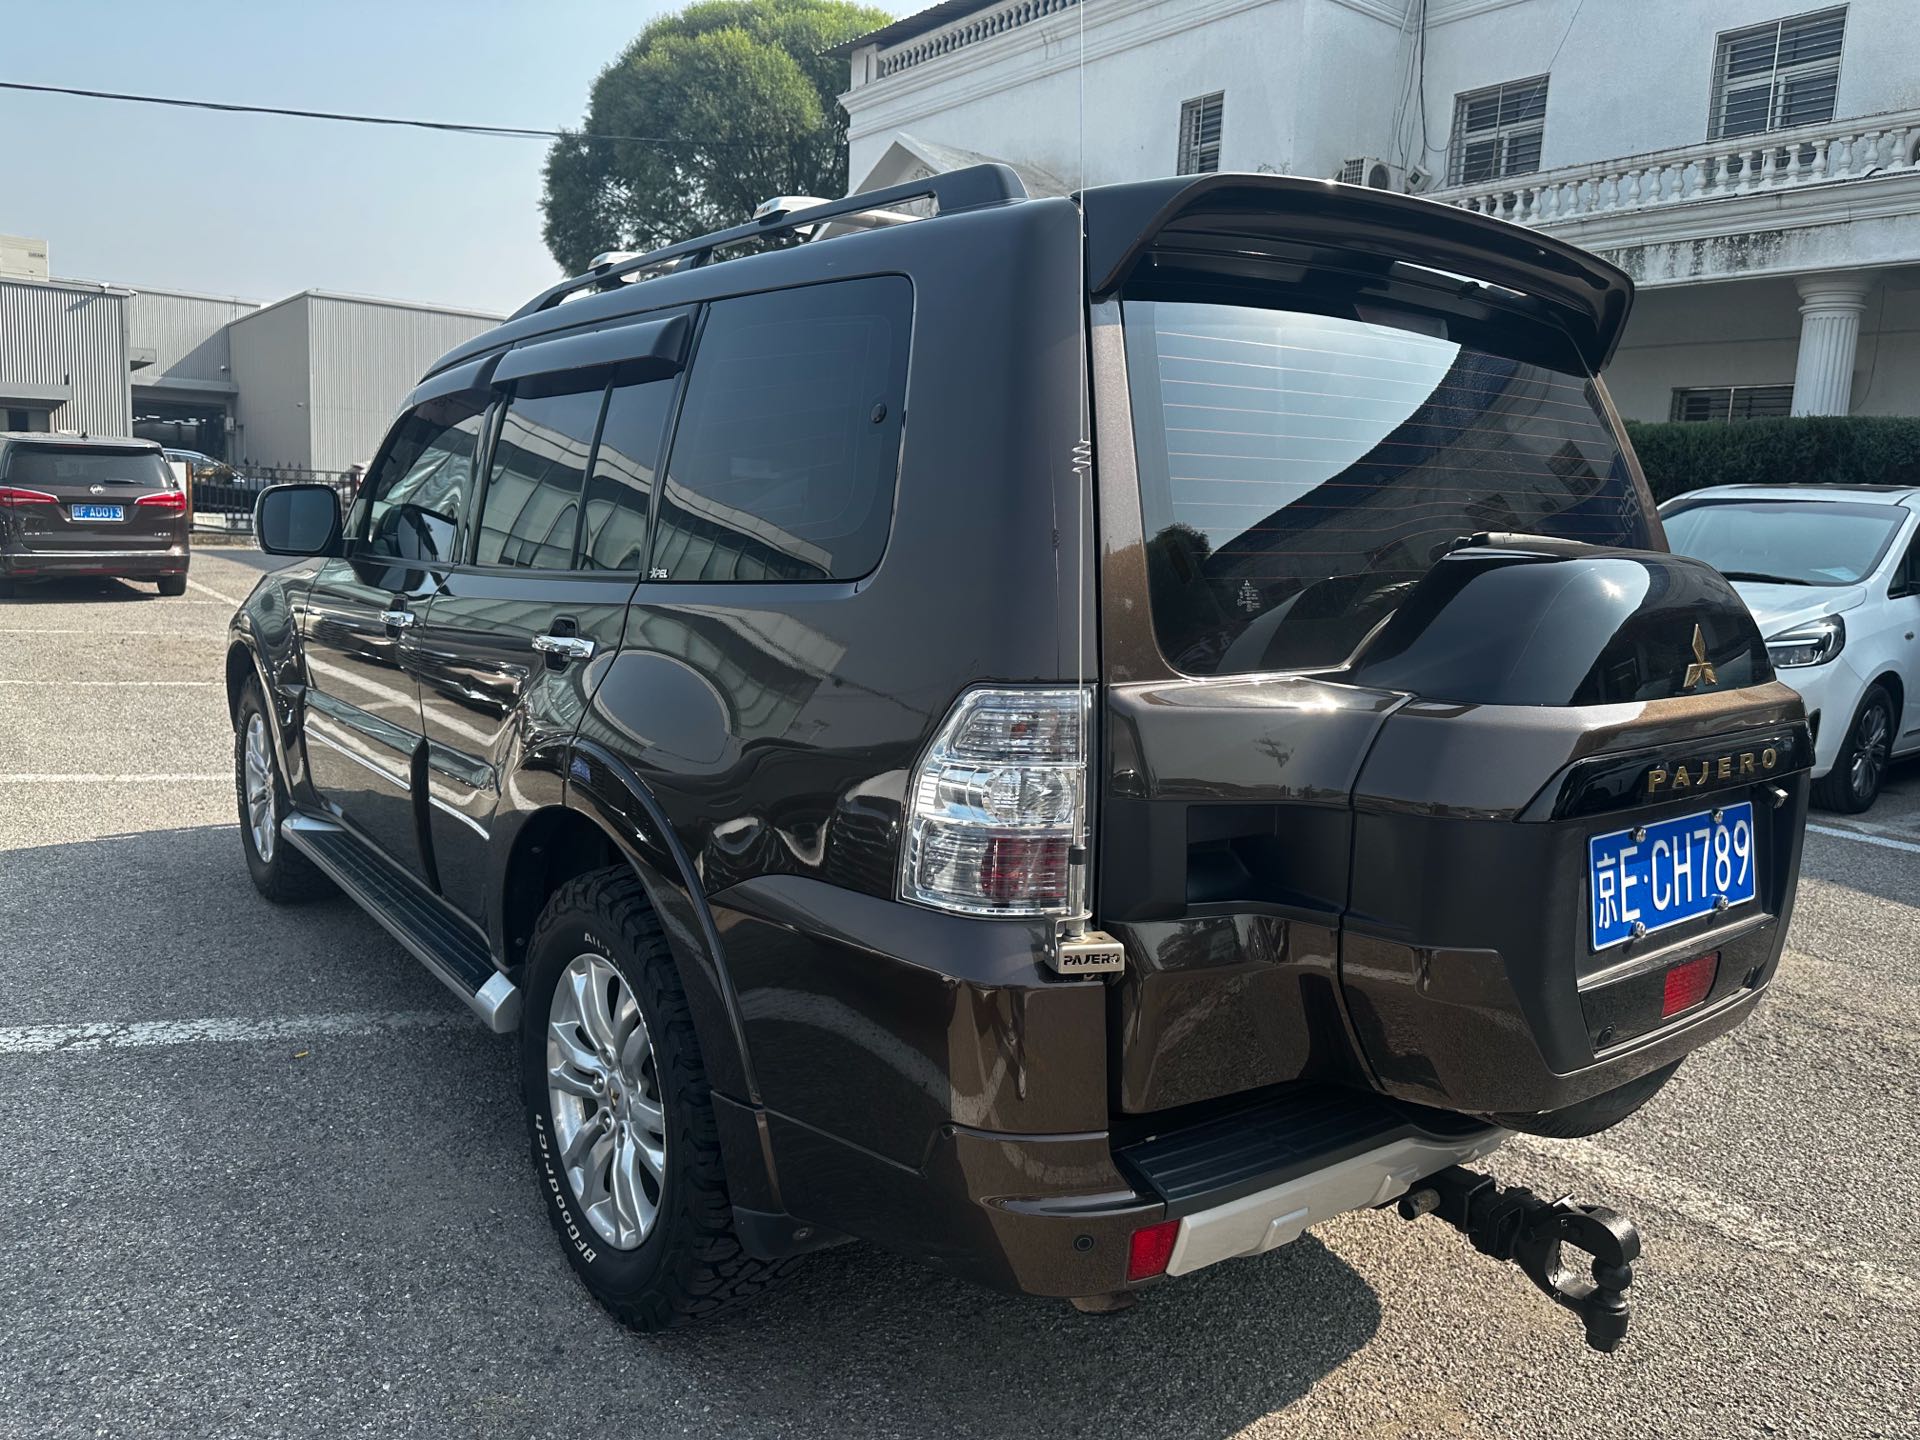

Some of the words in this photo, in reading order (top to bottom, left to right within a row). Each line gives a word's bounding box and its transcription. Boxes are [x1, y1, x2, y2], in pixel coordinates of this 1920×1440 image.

[1648, 748, 1777, 793] PAJERO
[1596, 820, 1749, 930] 京E·CH789
[1063, 953, 1120, 966] PAJERO
[535, 1113, 597, 1264] BFGoodrich
